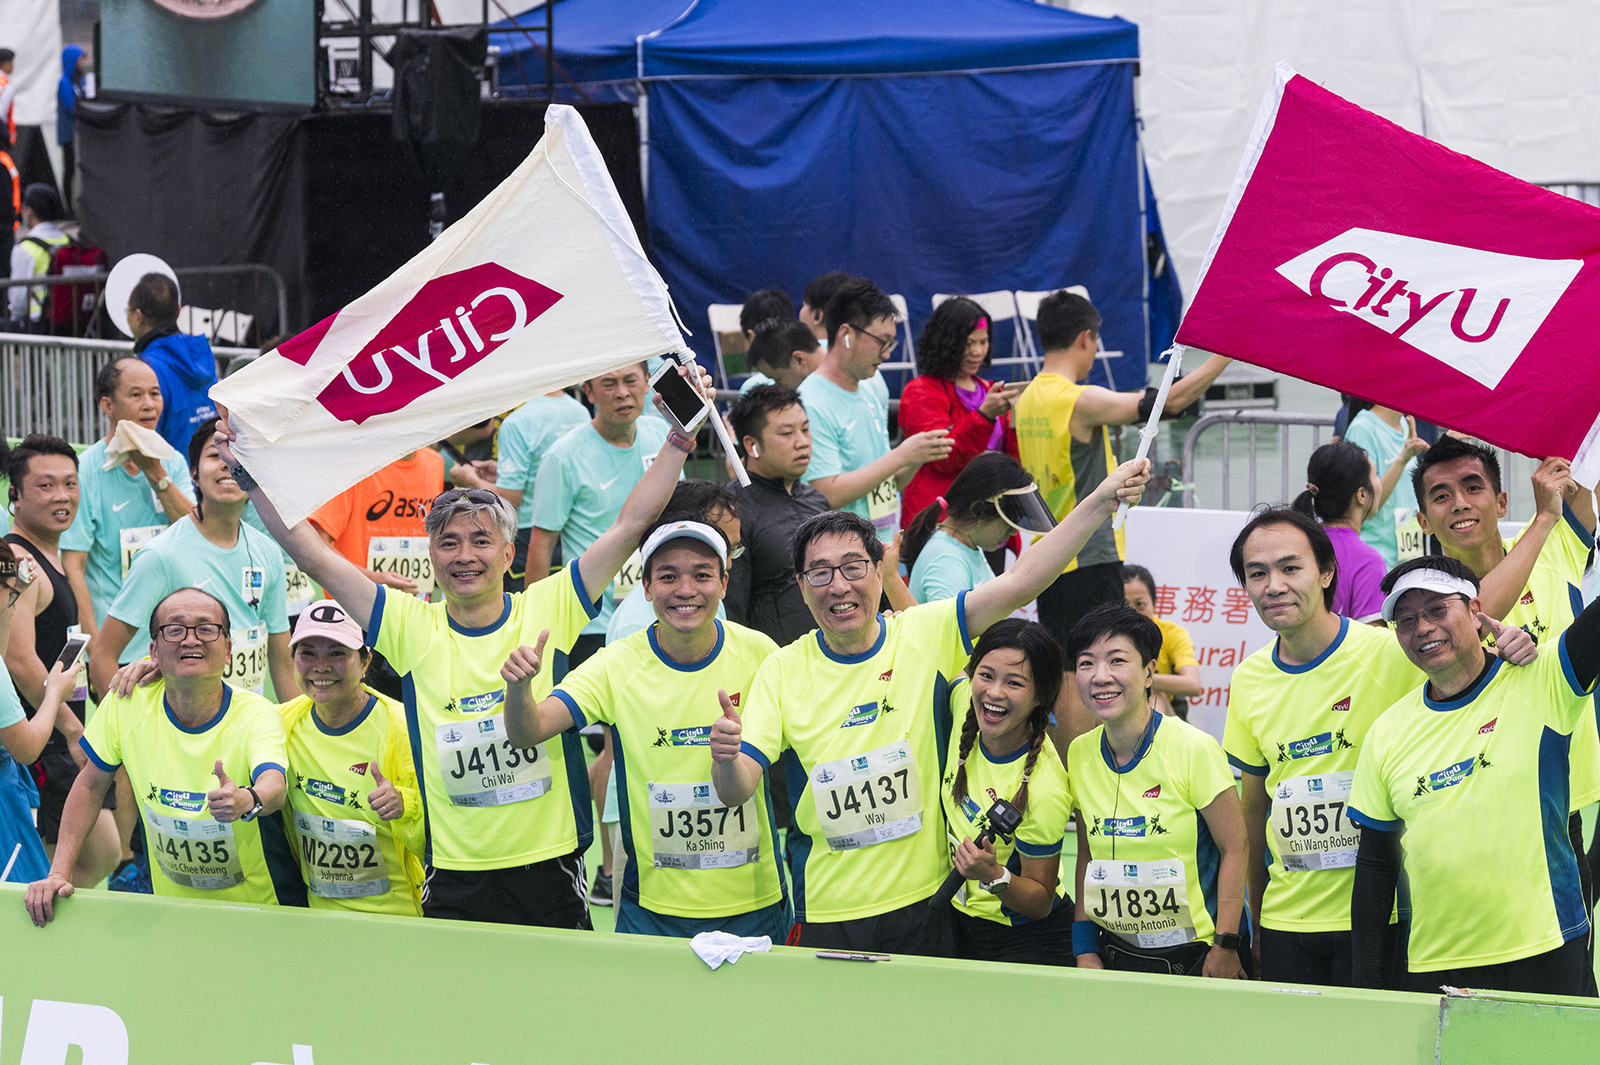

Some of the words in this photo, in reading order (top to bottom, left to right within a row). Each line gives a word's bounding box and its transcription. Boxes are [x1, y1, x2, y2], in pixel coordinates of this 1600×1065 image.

[1309, 252, 1511, 343] CityU
[1400, 531, 1422, 552] J04
[373, 557, 431, 579] K4093
[468, 693, 493, 708] CityU
[678, 727, 704, 741] CityU
[1294, 737, 1318, 753] CityU
[1302, 744, 1328, 757] Runner
[482, 775, 497, 788] Chi
[496, 771, 516, 786] Wai
[1436, 764, 1462, 783] CityU
[311, 781, 334, 792] CityU
[165, 791, 190, 803] CityU
[315, 790, 341, 800] Runner
[826, 768, 909, 821] J4137
[169, 801, 199, 809] Runner
[659, 804, 746, 838] J3571
[865, 812, 886, 826] Way
[1110, 819, 1134, 831] CityU
[1114, 827, 1142, 835] Runner
[155, 832, 230, 864] J4135
[686, 841, 697, 852] Ka
[699, 839, 725, 852] Shing
[1290, 839, 1302, 853] Chi
[1305, 838, 1329, 853] Wang
[1329, 832, 1361, 848] Robert
[302, 834, 378, 870] M2292
[179, 863, 201, 874] Chee
[200, 865, 228, 877] Keung
[320, 869, 354, 883] Julyanna
[1093, 887, 1180, 919] J1834
[1115, 920, 1140, 934] Hung
[1140, 916, 1177, 930] Antonia
